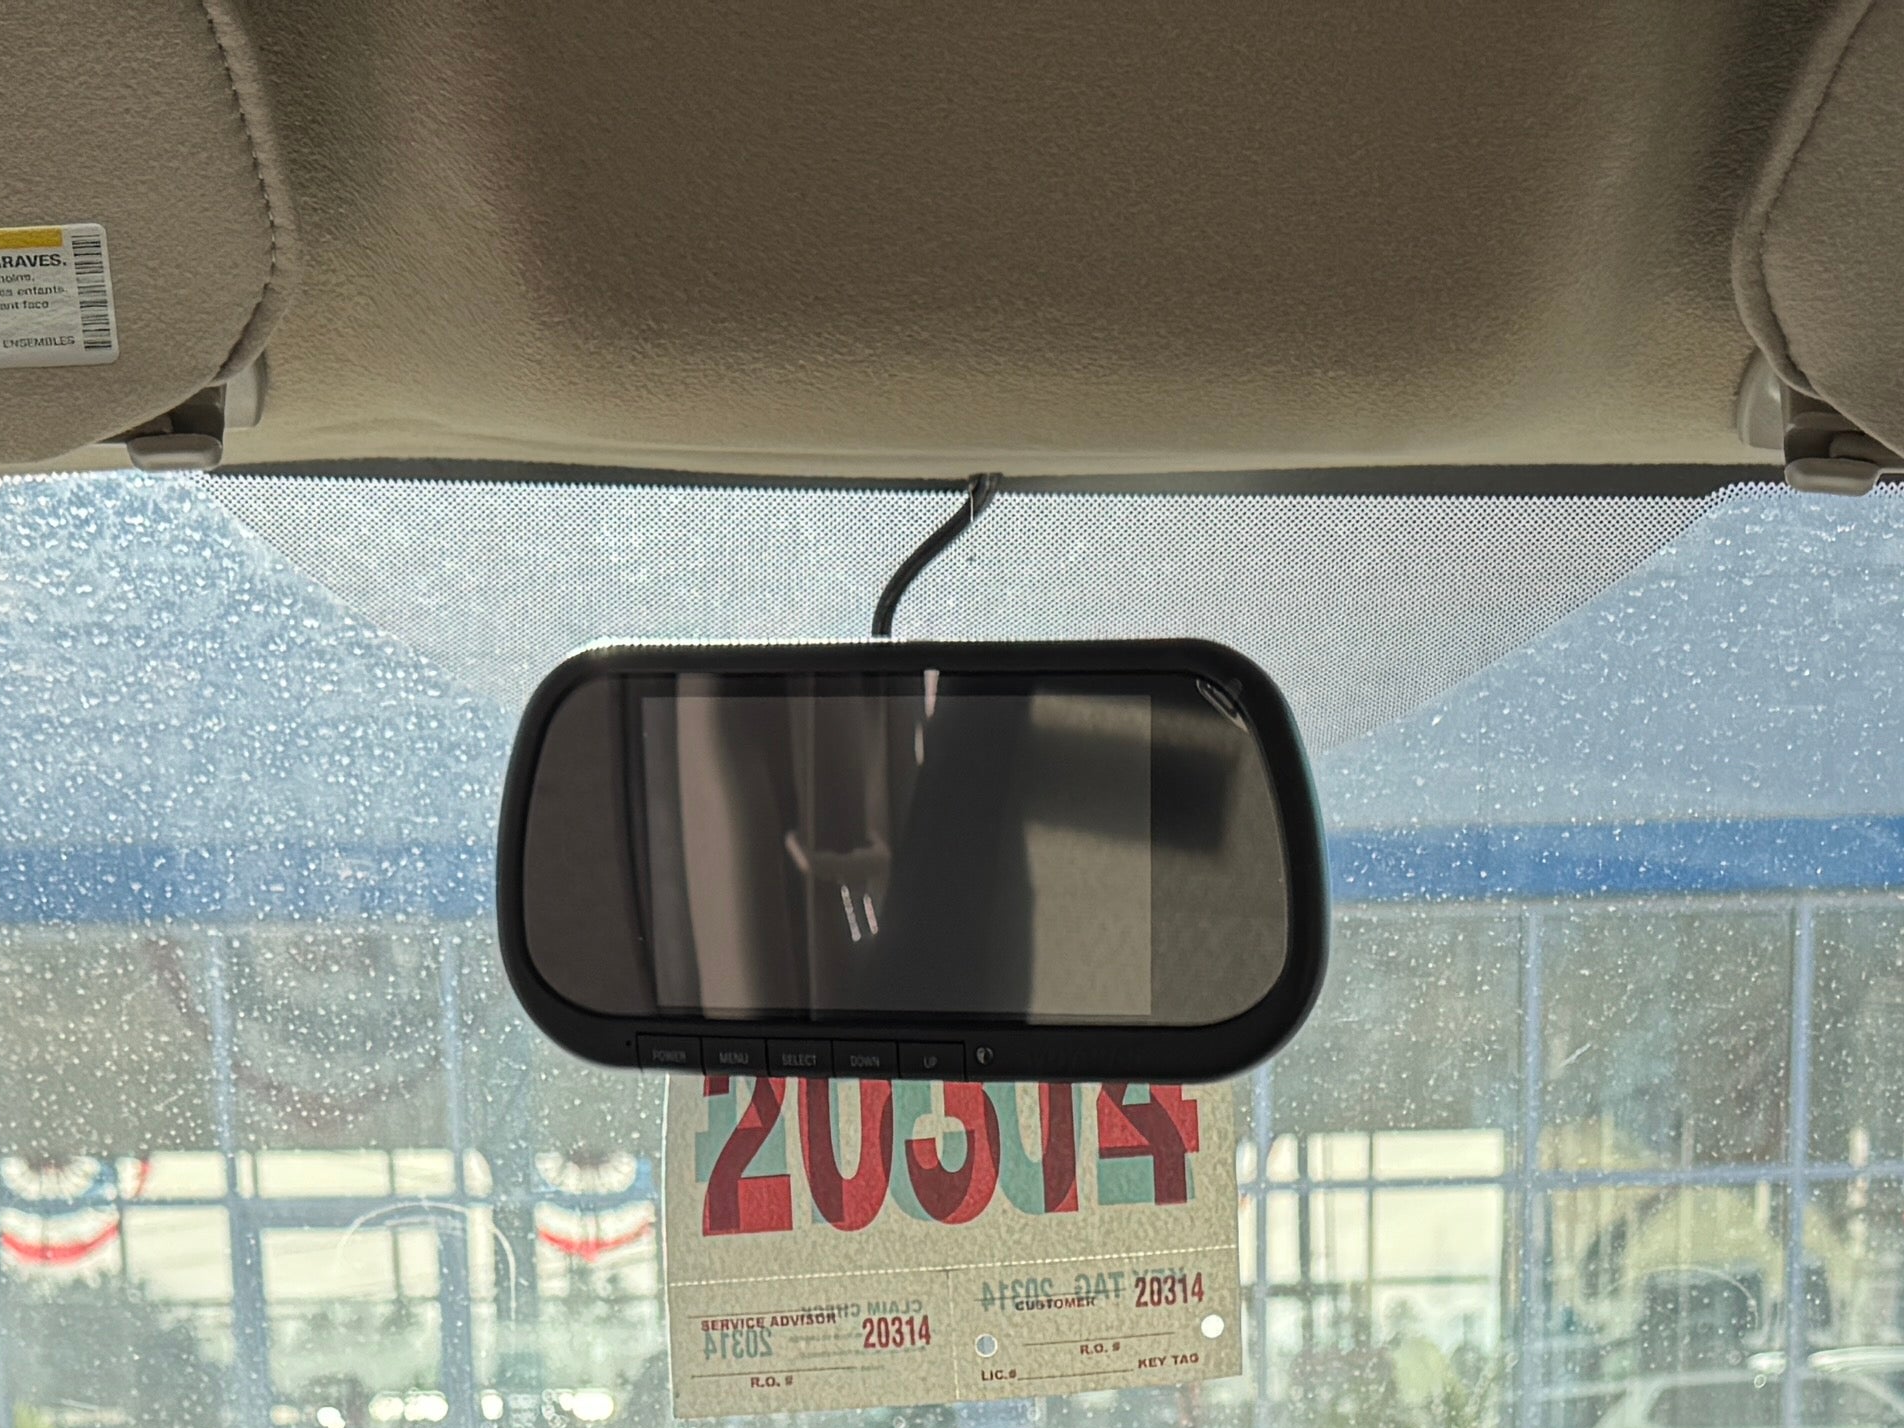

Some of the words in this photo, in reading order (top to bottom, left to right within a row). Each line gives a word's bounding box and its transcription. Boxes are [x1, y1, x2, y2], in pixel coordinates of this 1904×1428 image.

[653, 1050, 686, 1061] POWER
[720, 1052, 748, 1064] MENU
[782, 1054, 816, 1065] SELECT
[851, 1055, 879, 1068] DOWN
[924, 1056, 937, 1068] UP
[1135, 1272, 1205, 1308] 20314
[1015, 1297, 1095, 1311] CUSTOMER
[701, 1316, 765, 1332] SERVICE
[770, 1312, 836, 1328] ADVISOR
[862, 1315, 932, 1348] 20314
[1080, 1343, 1107, 1355] R.O.
[1138, 1356, 1166, 1369] KEY
[1171, 1353, 1199, 1365] TAG
[751, 1376, 780, 1388] R.O.
